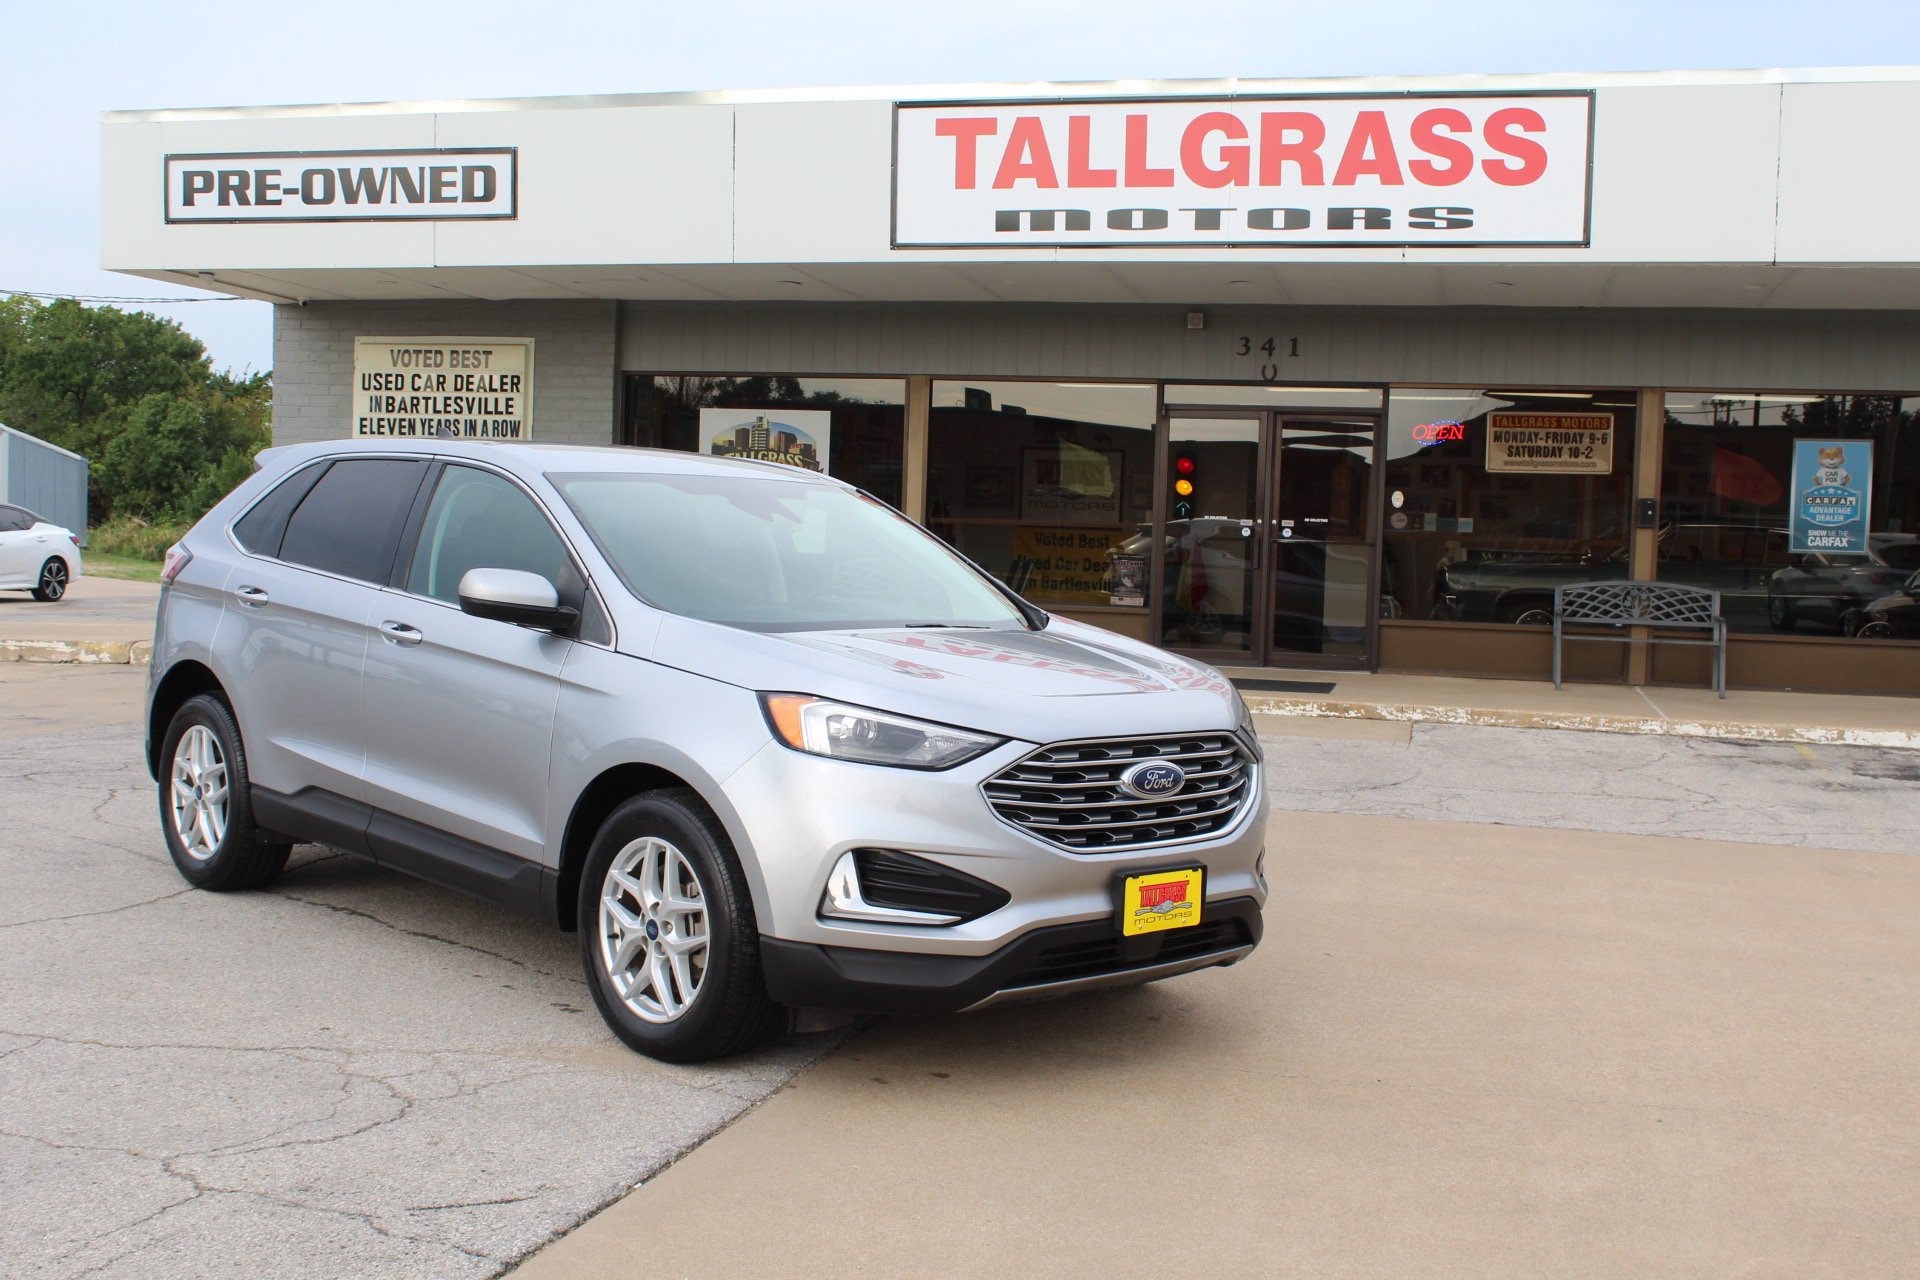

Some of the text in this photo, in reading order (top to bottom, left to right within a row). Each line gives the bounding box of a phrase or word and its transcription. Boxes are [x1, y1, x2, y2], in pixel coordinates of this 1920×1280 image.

[935, 107, 1548, 190] TALLGRASS
[182, 165, 496, 207] PRE-OWNED
[995, 207, 1474, 233] MOTORS
[1236, 336, 1301, 358] 341
[390, 349, 493, 368] VOTED BEST
[362, 372, 521, 392] USED CAR DEALER
[369, 395, 514, 415] IN BARTLESVILLE
[359, 417, 416, 436] ELEVEN
[464, 419, 478, 437] IN
[481, 419, 489, 437] A
[492, 419, 521, 438] ROW
[1495, 416, 1609, 430] TALLGRASS MOTORS
[1411, 424, 1465, 441] OPEN
[1493, 430, 1608, 446] MONDAY-FRIDAY 9-6
[1507, 445, 1593, 459] SATURDAY 10-2
[1806, 496, 1856, 505] CARFAX
[1809, 506, 1852, 515] ADVANTAGE
[1034, 531, 1110, 549] Voted Best
[1808, 536, 1848, 547] CARFAX
[1056, 556, 1078, 571] Car
[1041, 576, 1112, 592] Bartlesvill
[1144, 769, 1174, 790] Ford
[1134, 910, 1193, 926] MOTORS
